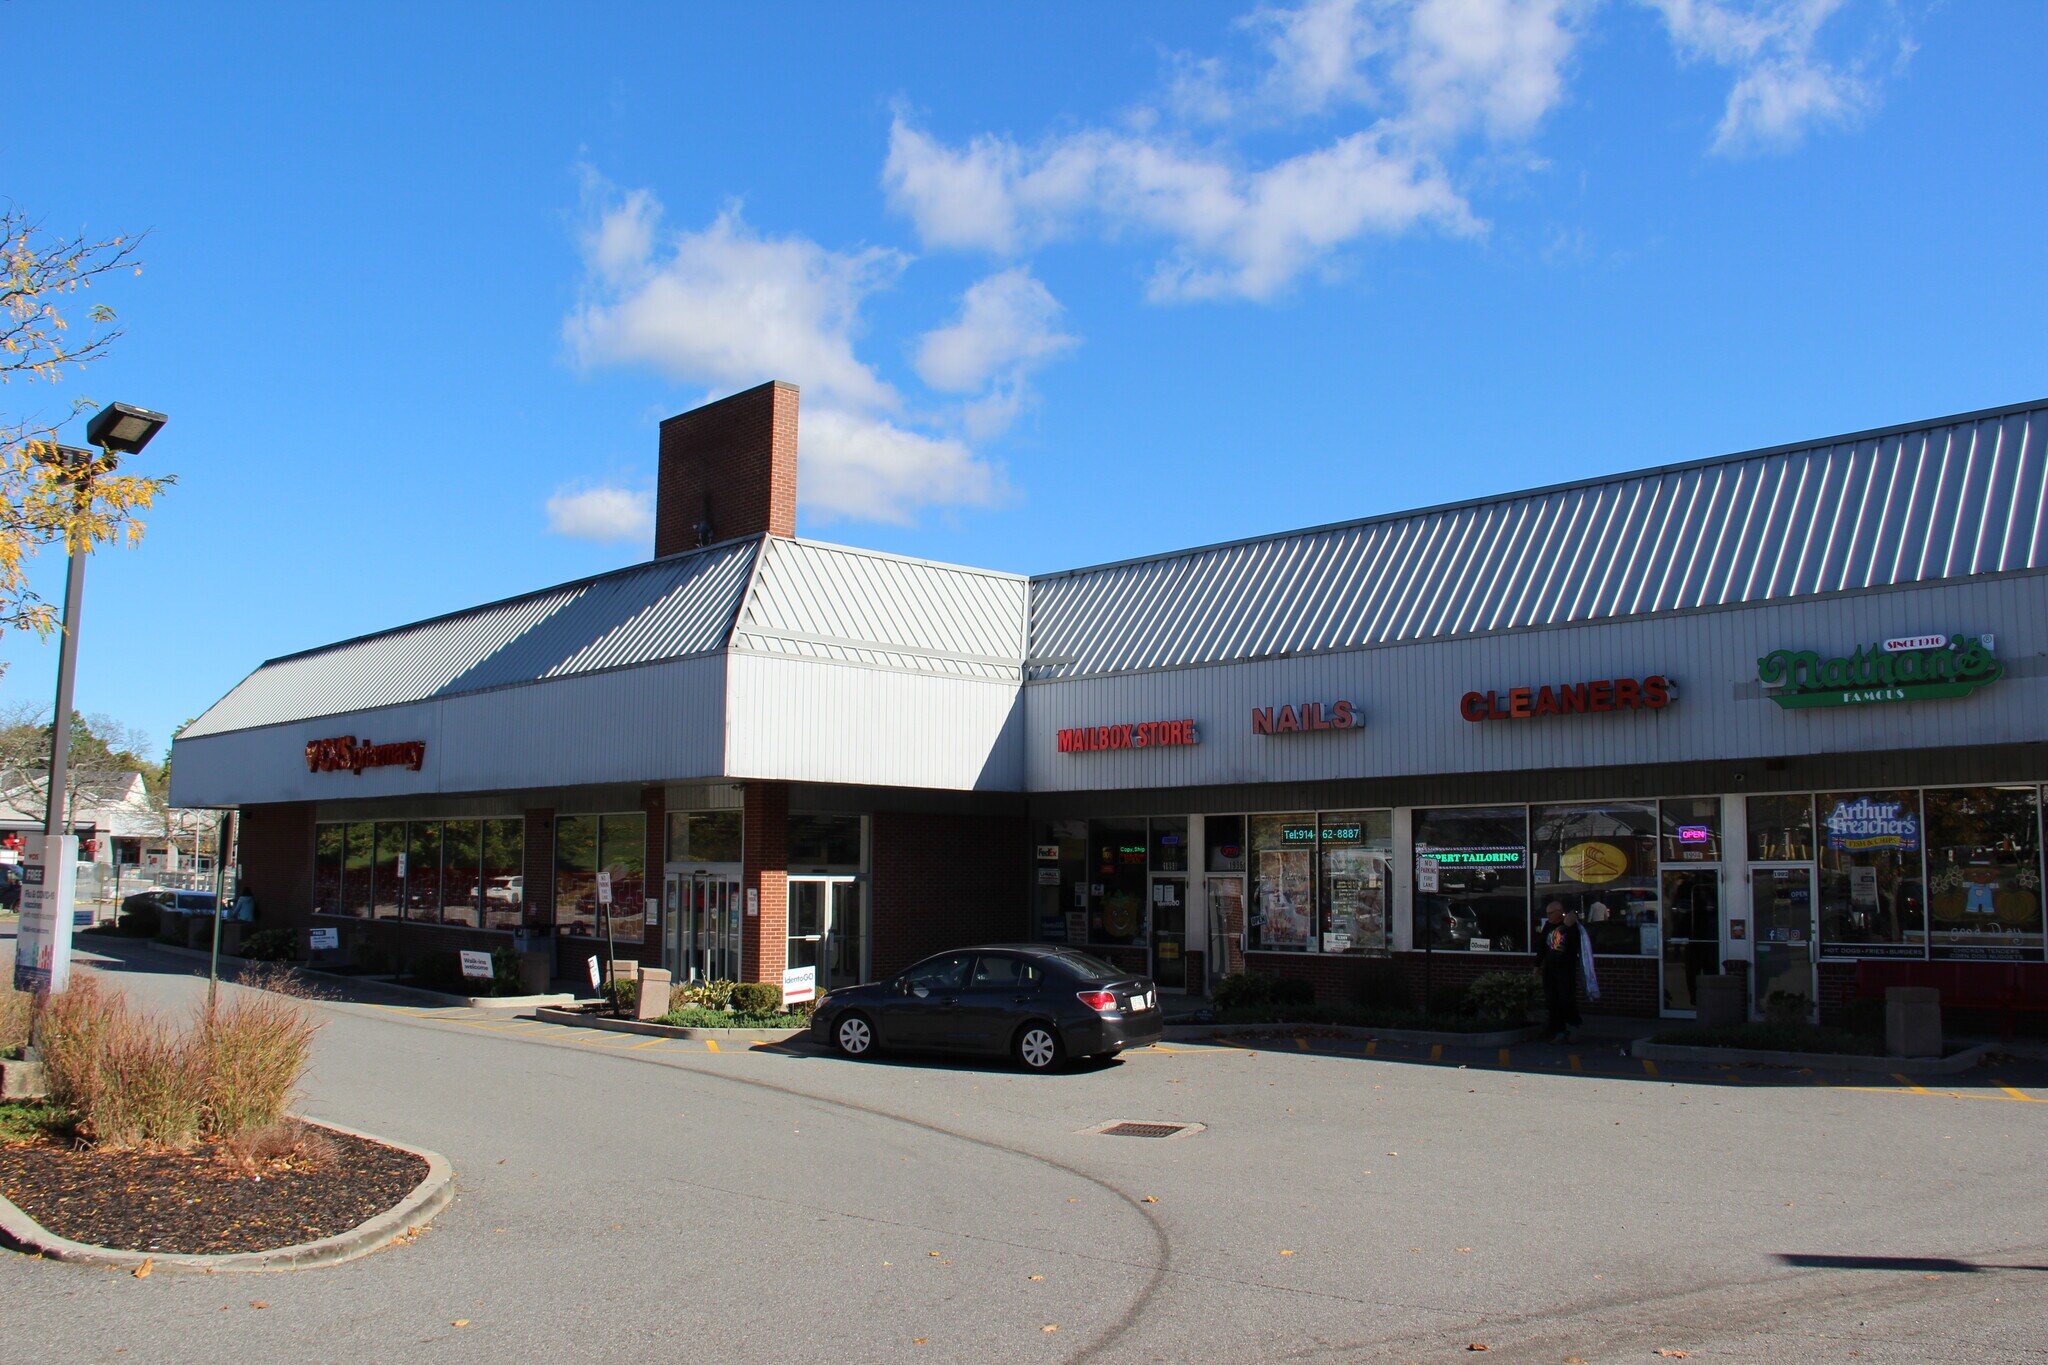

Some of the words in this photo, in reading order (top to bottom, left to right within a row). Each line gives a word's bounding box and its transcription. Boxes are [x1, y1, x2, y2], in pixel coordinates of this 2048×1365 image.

[1887, 638, 1915, 649] SINCE
[1917, 636, 1942, 647] 1916
[1757, 634, 1993, 691] Nathan's
[1460, 674, 1669, 723] CLEANERS
[1843, 688, 1904, 703] FAMOUS
[1252, 699, 1353, 735] NAILS
[1057, 723, 1133, 753] MAILBOX
[1136, 719, 1194, 747] STORE
[1831, 799, 1900, 820] Arthur
[1828, 814, 1917, 835] Treacher's
[1284, 829, 1360, 840] Tel:914-62-8887
[1682, 829, 1706, 839] OPEN
[1038, 847, 1057, 857] FedEx
[1462, 853, 1520, 862] TAILORING
[785, 972, 814, 985] IdentoGO
